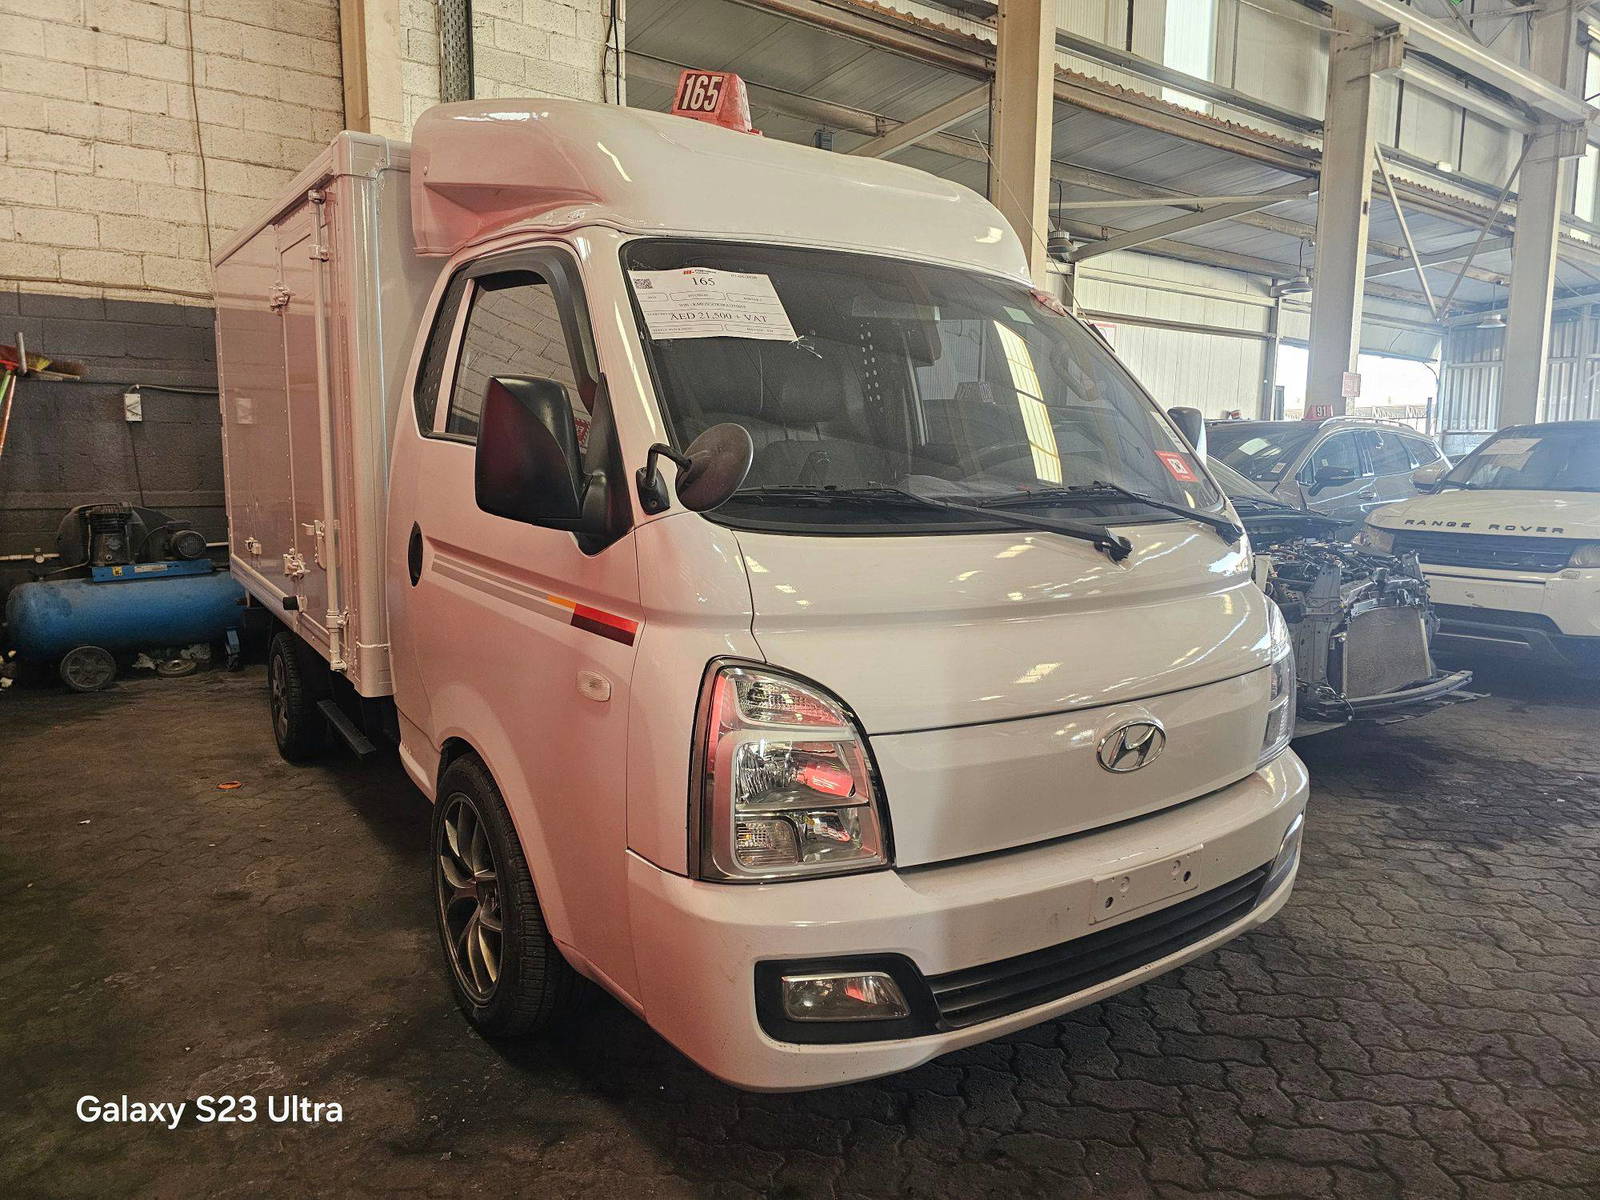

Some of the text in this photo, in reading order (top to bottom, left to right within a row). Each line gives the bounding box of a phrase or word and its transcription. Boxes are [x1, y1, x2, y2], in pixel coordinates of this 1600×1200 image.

[681, 74, 723, 111] 165
[692, 276, 716, 286] 165
[670, 312, 696, 321] AED
[743, 314, 768, 323] VAT
[1404, 519, 1564, 534] RANGE ROVER
